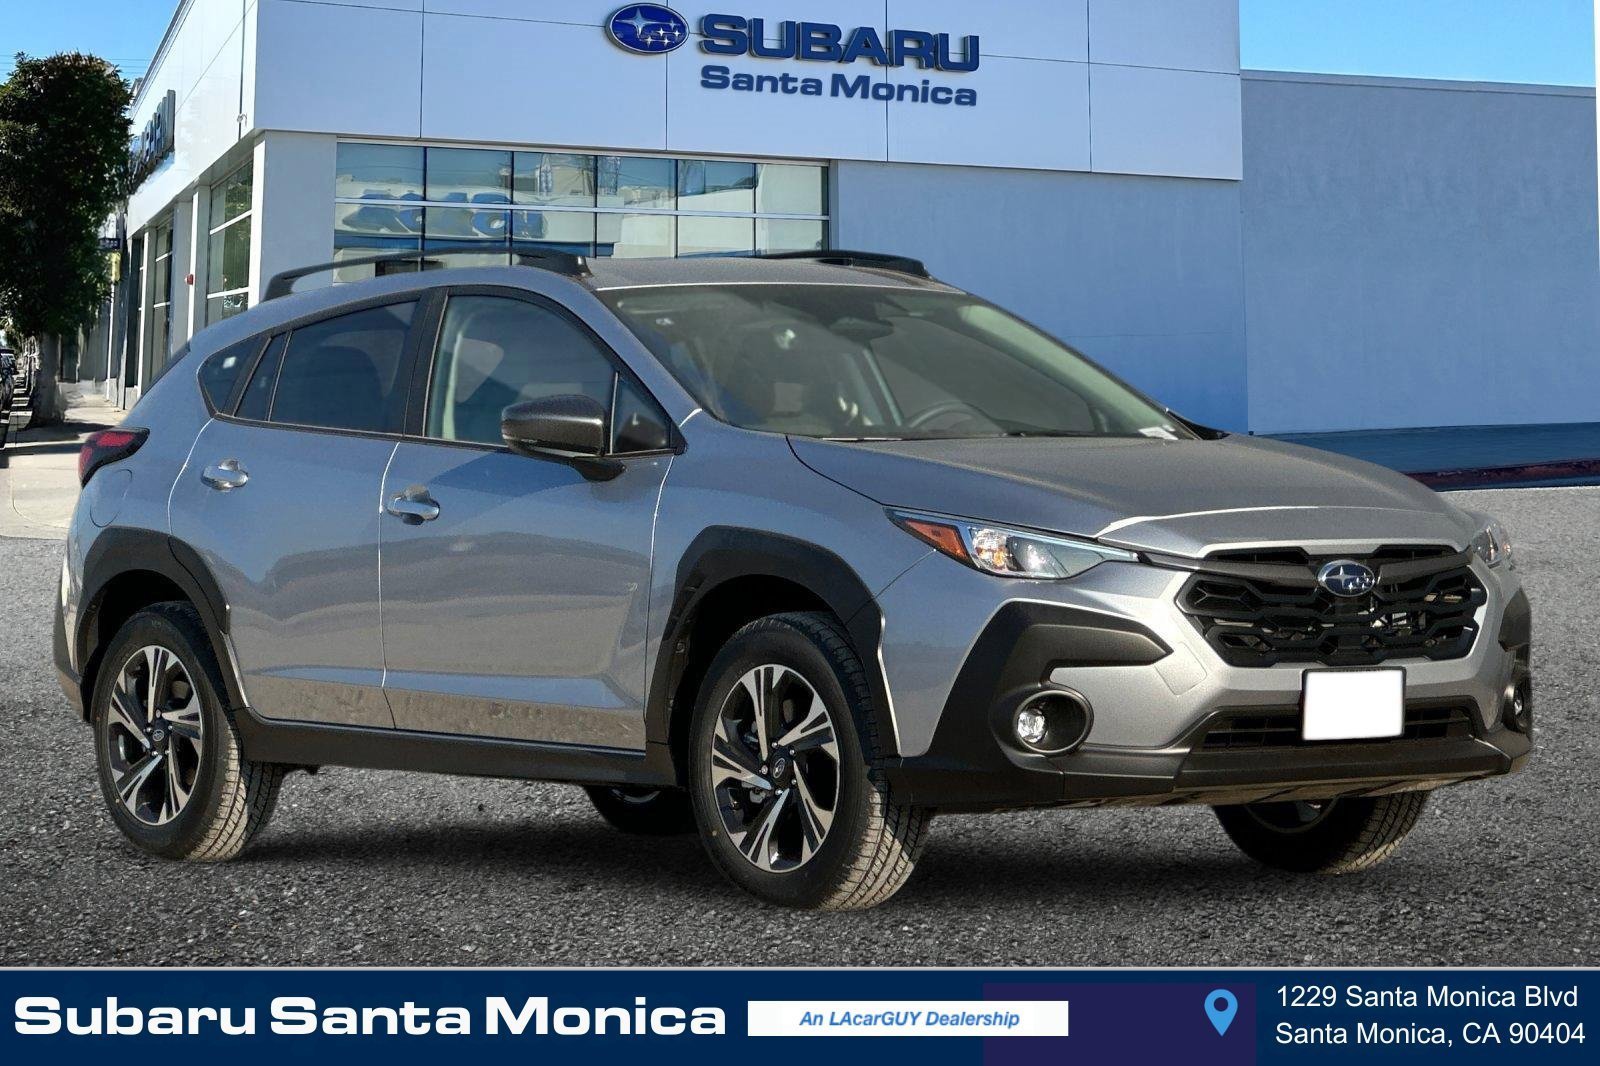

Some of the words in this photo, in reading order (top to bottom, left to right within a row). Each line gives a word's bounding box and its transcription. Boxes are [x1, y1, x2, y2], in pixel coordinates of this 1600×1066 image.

[699, 13, 979, 71] SUBARU
[700, 65, 823, 96] Santa
[830, 73, 977, 106] Monica
